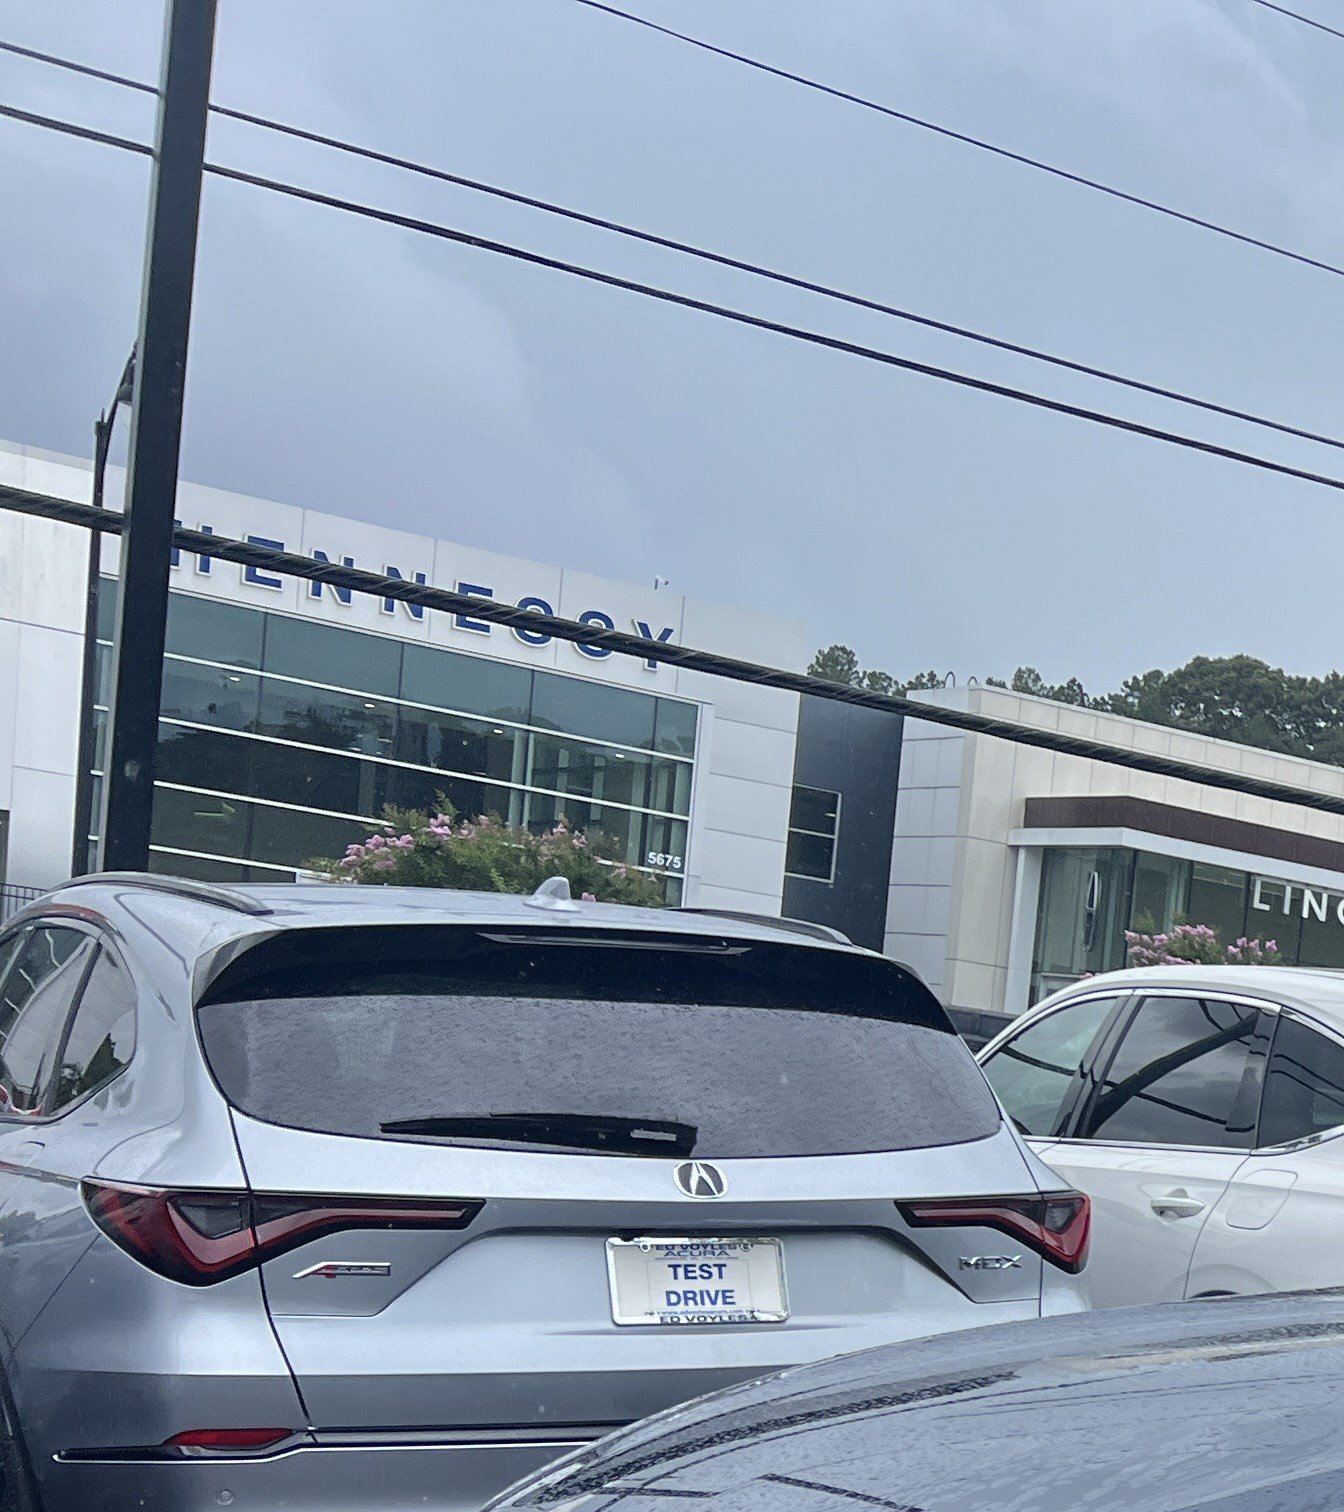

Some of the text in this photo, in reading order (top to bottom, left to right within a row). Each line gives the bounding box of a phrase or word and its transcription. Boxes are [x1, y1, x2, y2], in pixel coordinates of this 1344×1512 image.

[647, 851, 682, 869] 5675
[667, 1263, 727, 1281] TEST
[665, 1289, 737, 1307] DRIVE
